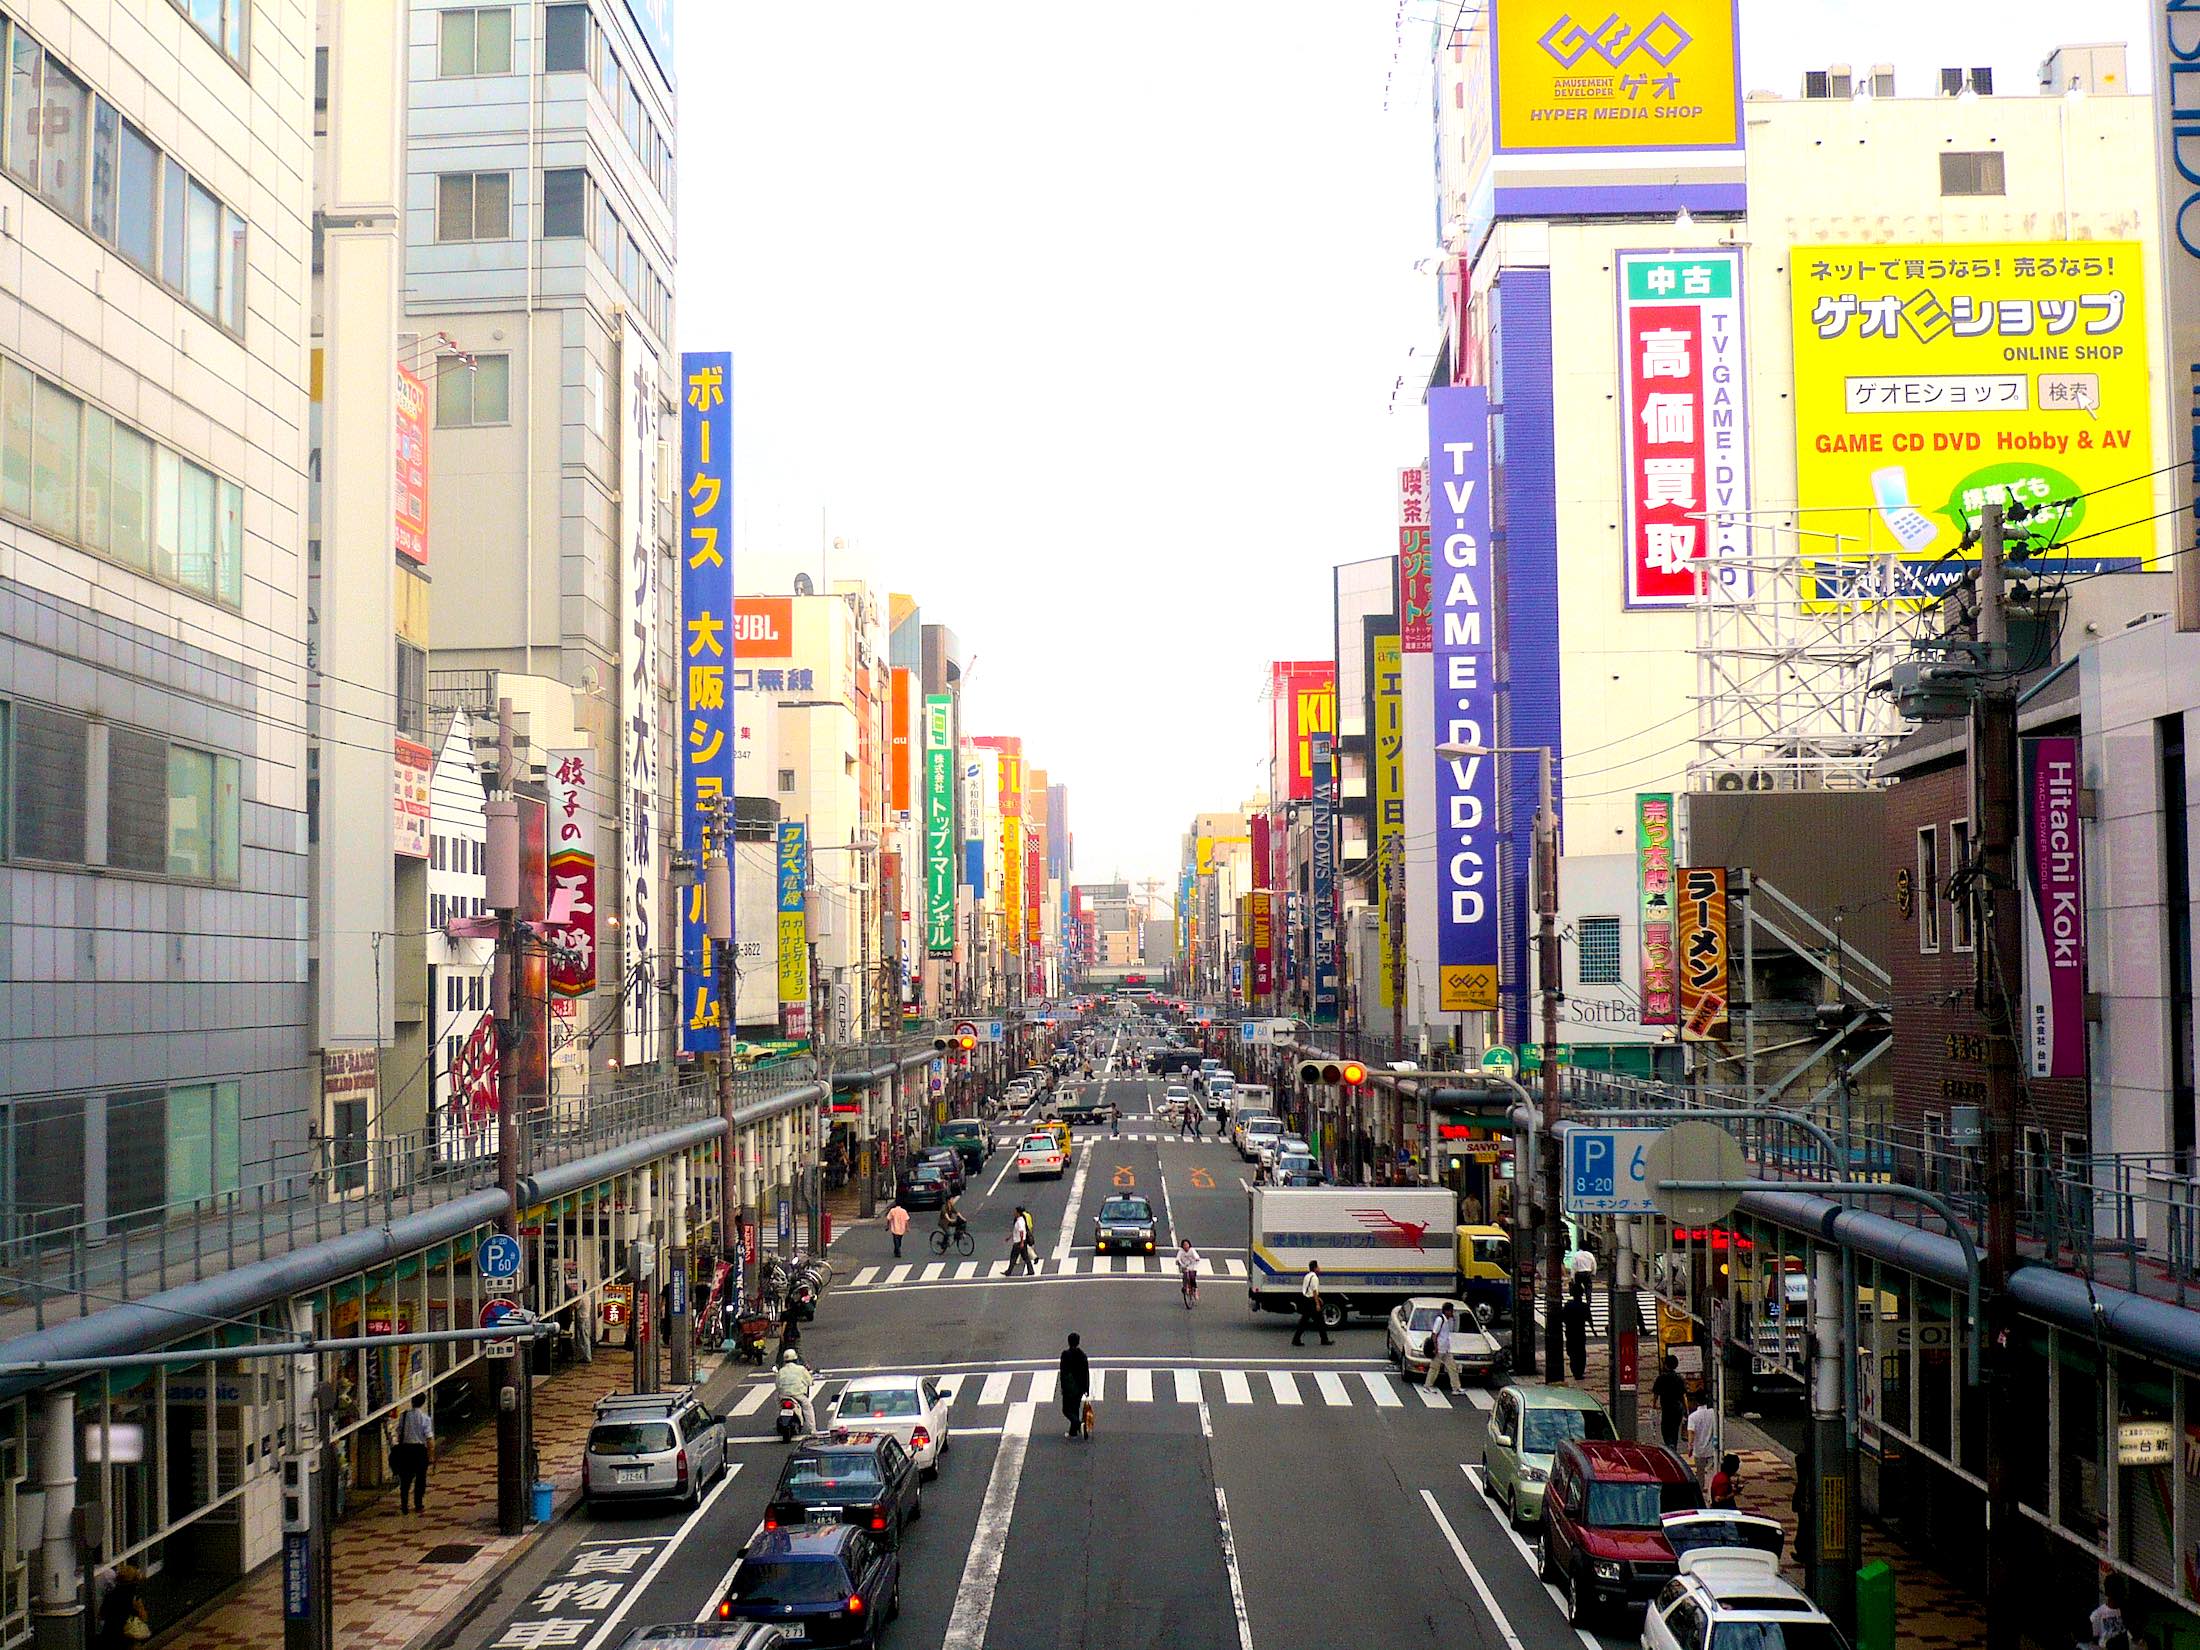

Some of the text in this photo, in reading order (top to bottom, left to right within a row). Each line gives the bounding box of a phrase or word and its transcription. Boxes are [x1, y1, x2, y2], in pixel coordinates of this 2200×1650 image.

[1554, 77, 1614, 88] AMUSEMENT
[1554, 87, 1614, 98] DEVELOPER
[1619, 73, 1681, 100] ゲオ
[1530, 105, 1703, 121] HYPER MEDIA SHOP
[1647, 265, 1712, 295] 中古
[2003, 345, 2124, 361] ONLINE SHOP
[1640, 327, 1698, 575] 高価買取
[1815, 430, 2131, 454] GAME CD DVD Hobby & AV
[687, 366, 725, 570] ボークス
[1402, 469, 1422, 523] 喫茶
[1403, 530, 1423, 625] リゾート
[735, 614, 779, 641] JBL
[893, 736, 907, 745] au
[556, 757, 586, 842] 餃子の
[2037, 772, 2046, 812] HITACHI
[1313, 783, 1332, 880] WINDOWS
[2039, 816, 2047, 852] POWER
[2048, 762, 2078, 968] Hitachi Koki
[1687, 871, 1719, 988] ラーメン
[838, 995, 847, 1044] ECLIPSE
[1585, 1140, 1606, 1173] P
[1576, 1178, 1613, 1192] 8-20
[488, 1245, 504, 1272] P
[498, 1258, 511, 1271] 60
